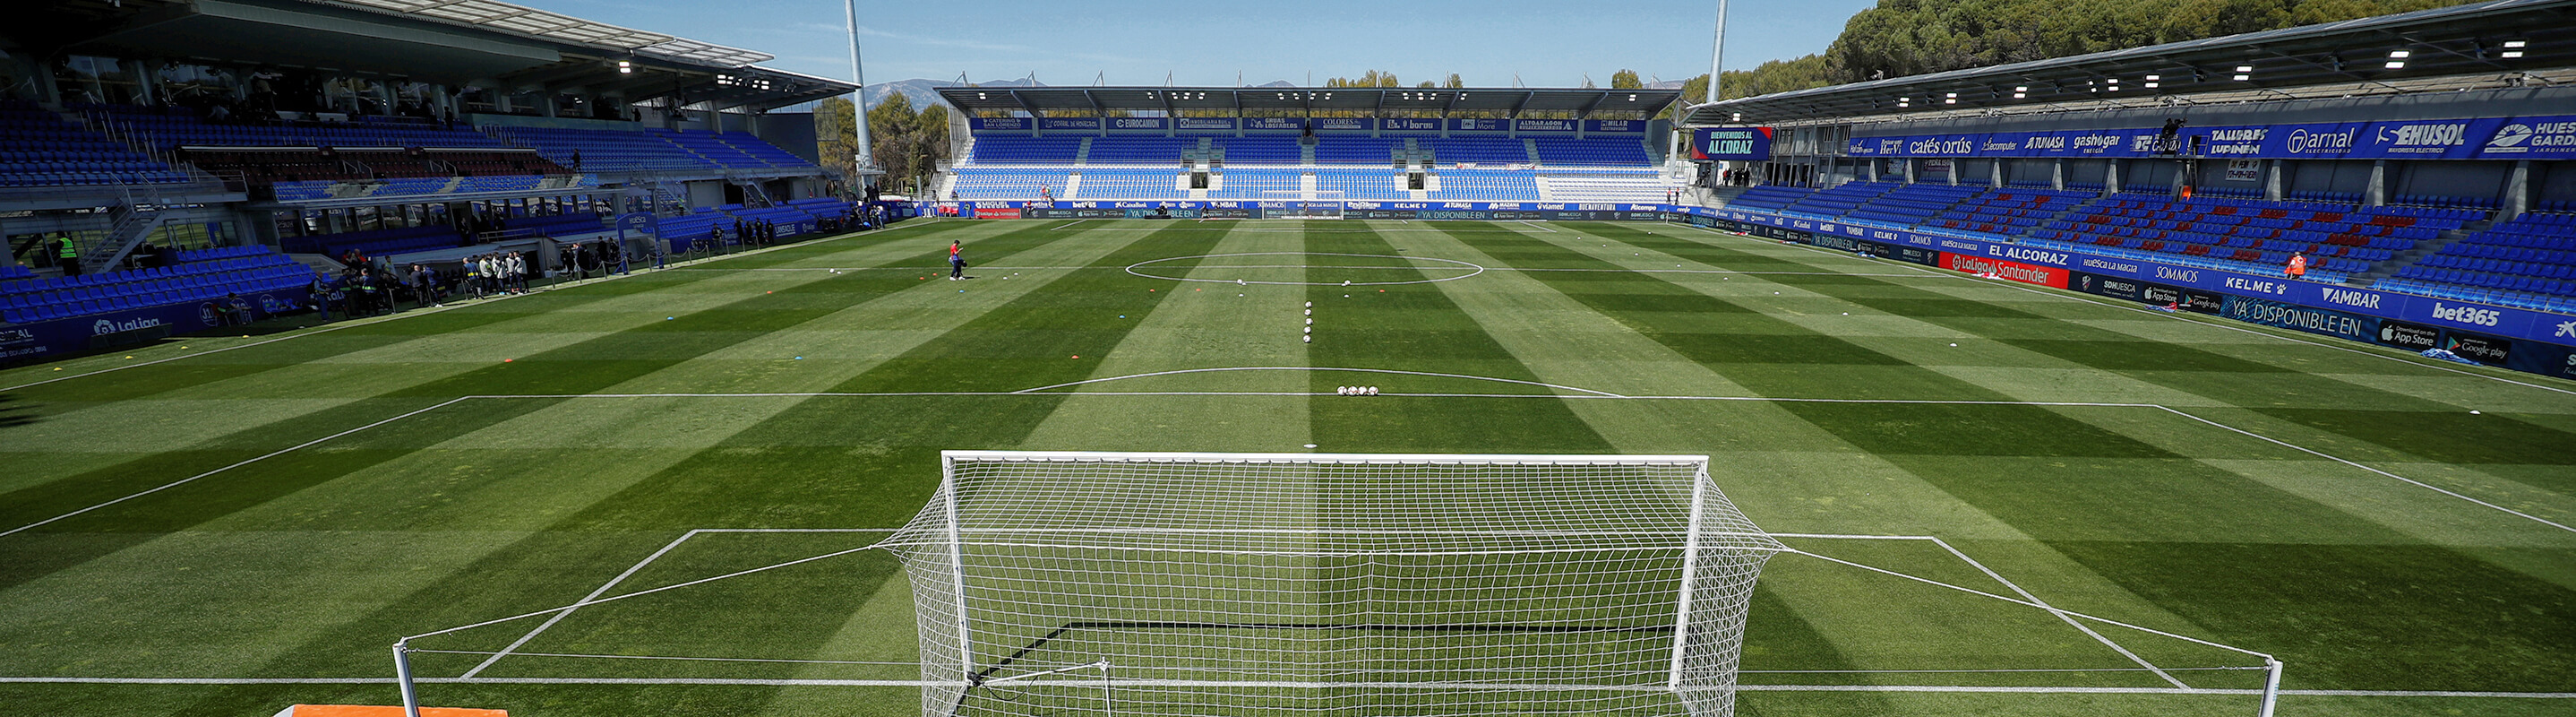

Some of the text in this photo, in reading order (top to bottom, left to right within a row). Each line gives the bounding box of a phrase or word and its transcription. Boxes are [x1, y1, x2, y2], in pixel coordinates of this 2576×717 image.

[1125, 119, 1160, 128] EUROCAMION
[1711, 131, 1753, 139] BIENVENIDOS AL
[2211, 129, 2269, 142] TALLERES
[2307, 126, 2356, 149] arnal
[1707, 140, 1754, 154] ALCORAZ
[1910, 136, 1972, 154] cafés orús
[2034, 136, 2065, 149] TUMASA
[2211, 141, 2261, 155] LUPIÑÉN
[1874, 230, 1893, 240] KELME
[1909, 234, 1932, 246] SOMMOS
[1988, 245, 2069, 265] EL ALCORAZ
[1962, 257, 2049, 284] LaLiga Santander
[2155, 265, 2199, 283] SOMMOS
[2103, 280, 2136, 293] SDHUESCA
[2225, 276, 2273, 294] KELME
[2151, 291, 2177, 303] App Store
[2193, 298, 2210, 307] Google
[2329, 289, 2381, 310] AMBAR
[2233, 300, 2362, 337] YA DISPONIBLE EN
[2431, 301, 2501, 327] bet365
[2395, 325, 2420, 335] Download
[2394, 332, 2434, 347] App Store
[2461, 341, 2489, 357] Google
[2489, 348, 2508, 359] play
